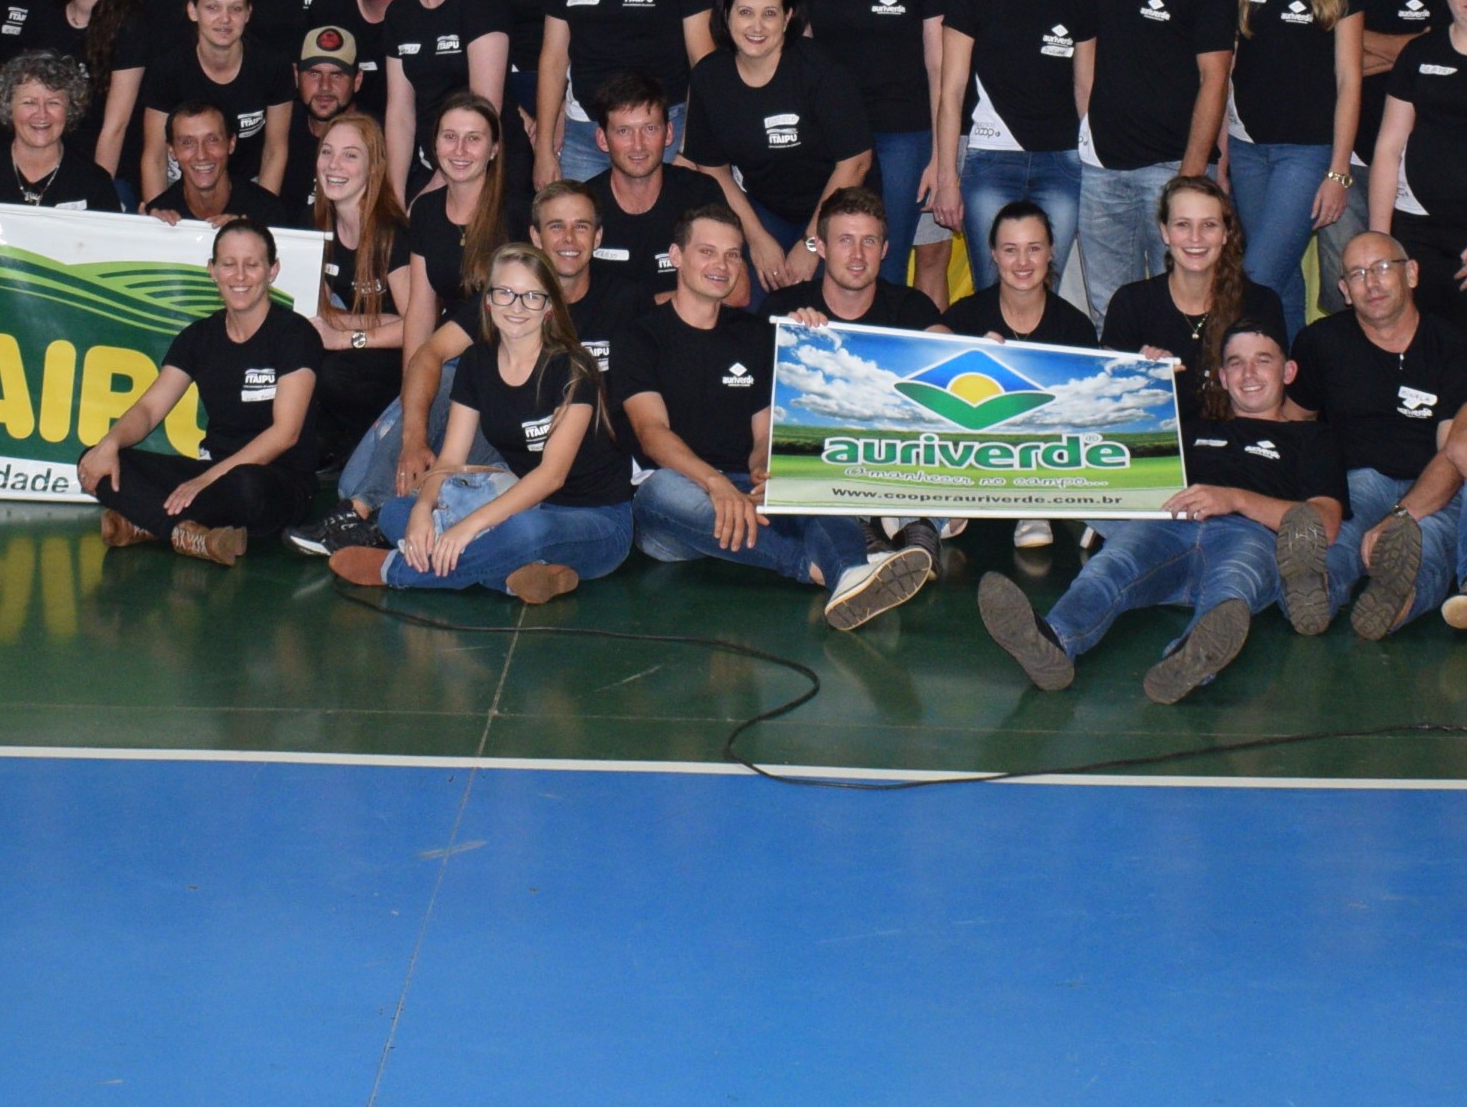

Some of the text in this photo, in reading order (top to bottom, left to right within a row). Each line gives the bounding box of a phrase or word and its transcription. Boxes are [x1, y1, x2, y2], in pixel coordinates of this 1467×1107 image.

[769, 134, 798, 144] ITAIPU
[245, 375, 276, 384] ITAIPU
[822, 433, 1131, 471] auriverde
[831, 487, 1123, 504] www.cooperauriverde.com.br
